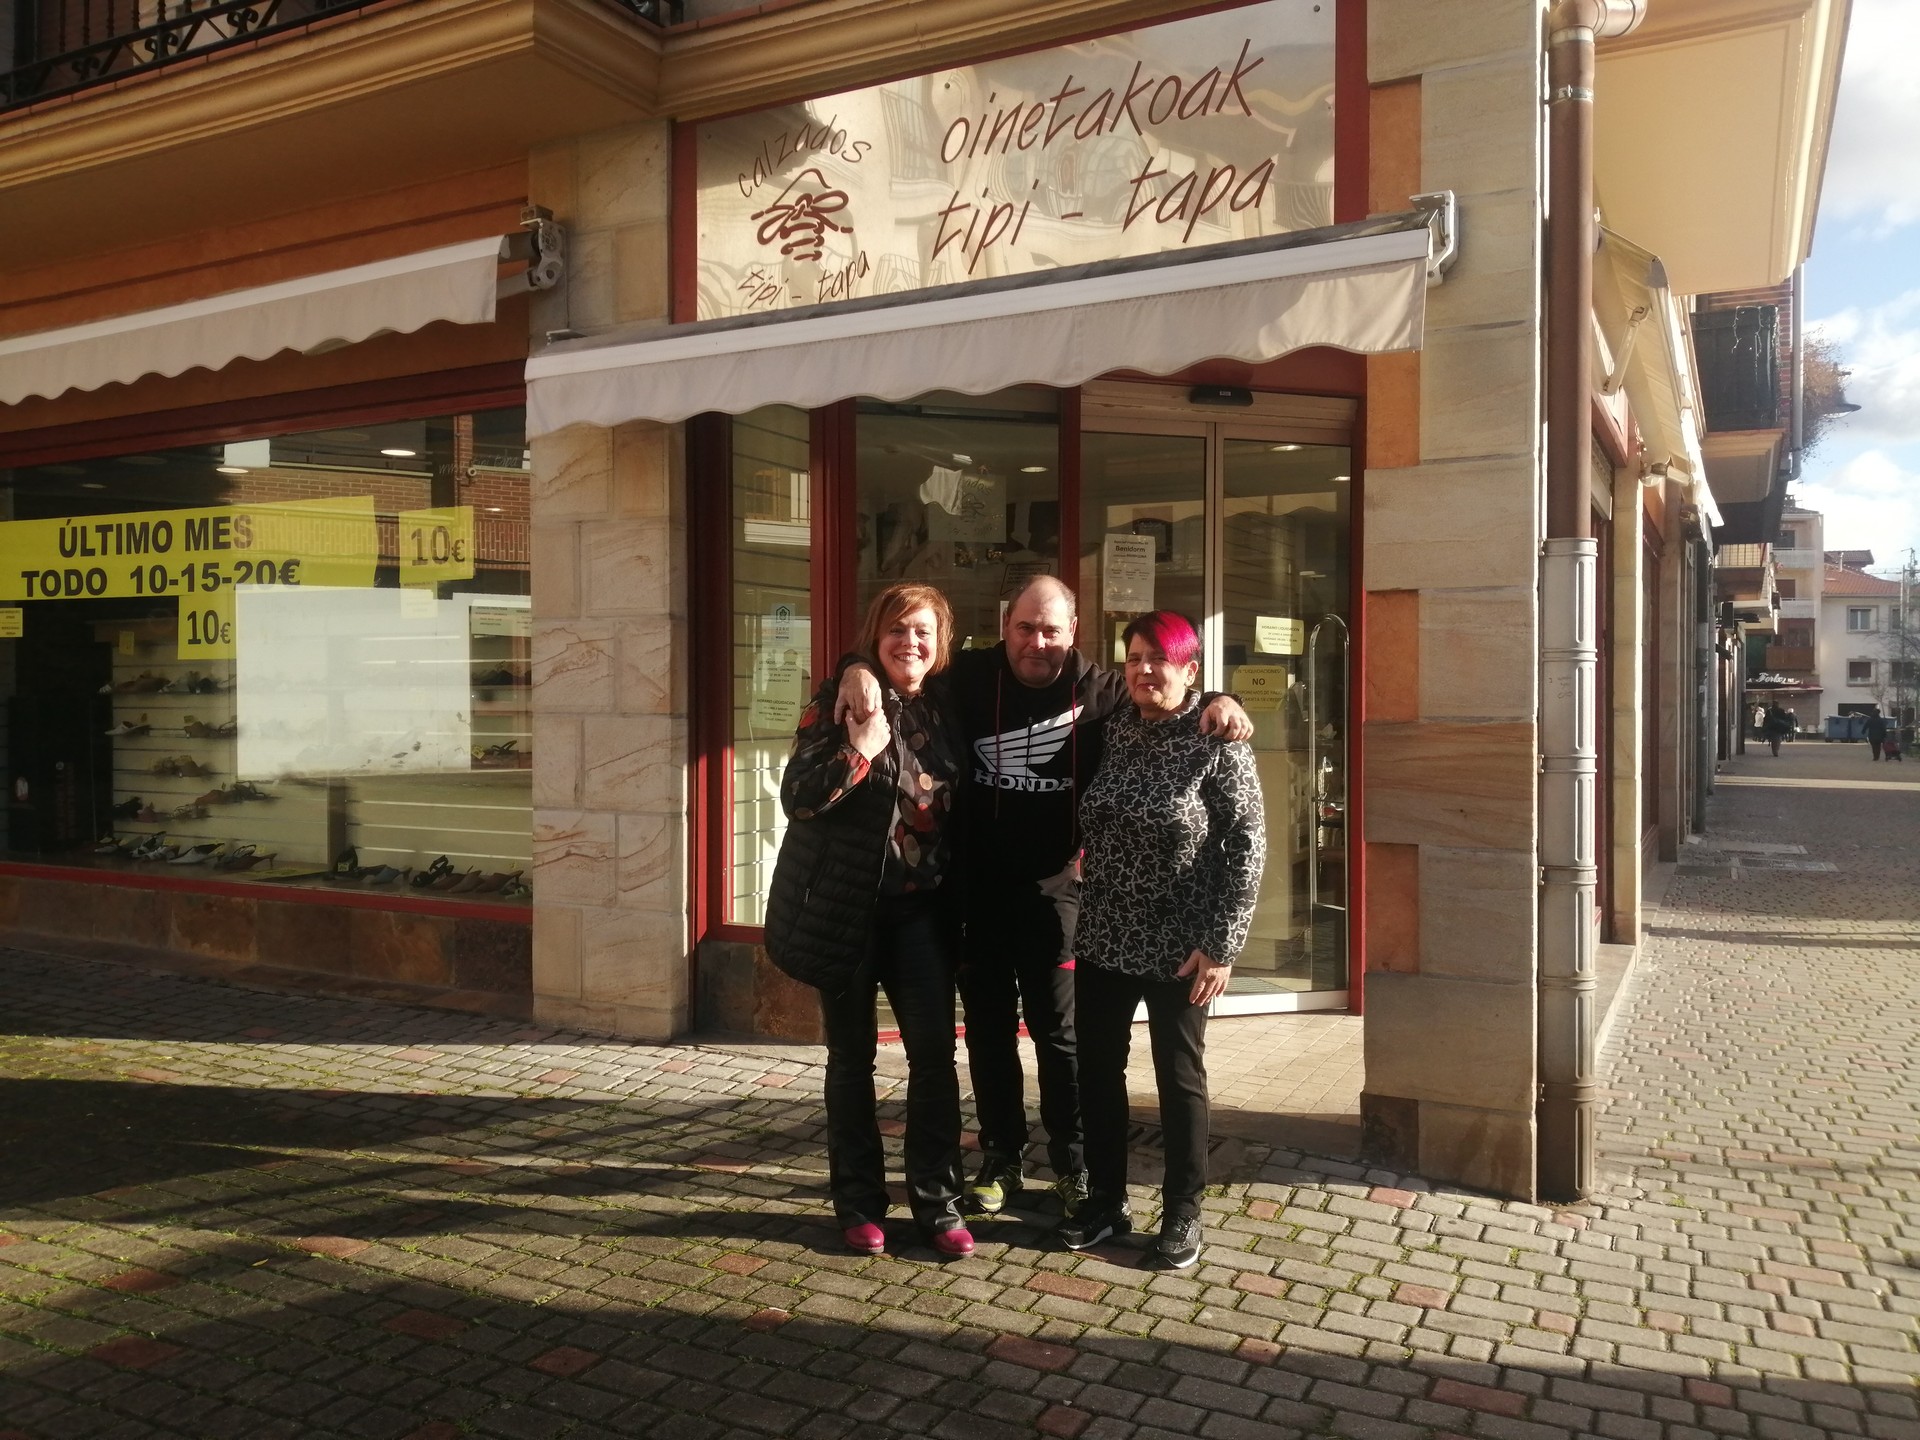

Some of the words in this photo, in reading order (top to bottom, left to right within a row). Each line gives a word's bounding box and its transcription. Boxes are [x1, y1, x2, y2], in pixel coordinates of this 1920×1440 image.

[941, 38, 1264, 163] oinetakoak
[738, 114, 872, 198] calzados
[931, 178, 1040, 275] tipi
[1123, 156, 1275, 243] tapa
[738, 269, 789, 309] tipi
[818, 250, 870, 304] tapa
[58, 519, 173, 559] ÚLTIMO
[184, 514, 254, 552] MES
[411, 525, 465, 566] 10€
[1115, 545, 1146, 553] Benidorm
[21, 567, 108, 598] TODO
[130, 558, 301, 594] 10-15-20€
[187, 609, 231, 645] 10€
[1252, 678, 1265, 686] NO
[975, 768, 1074, 792] HONDA
